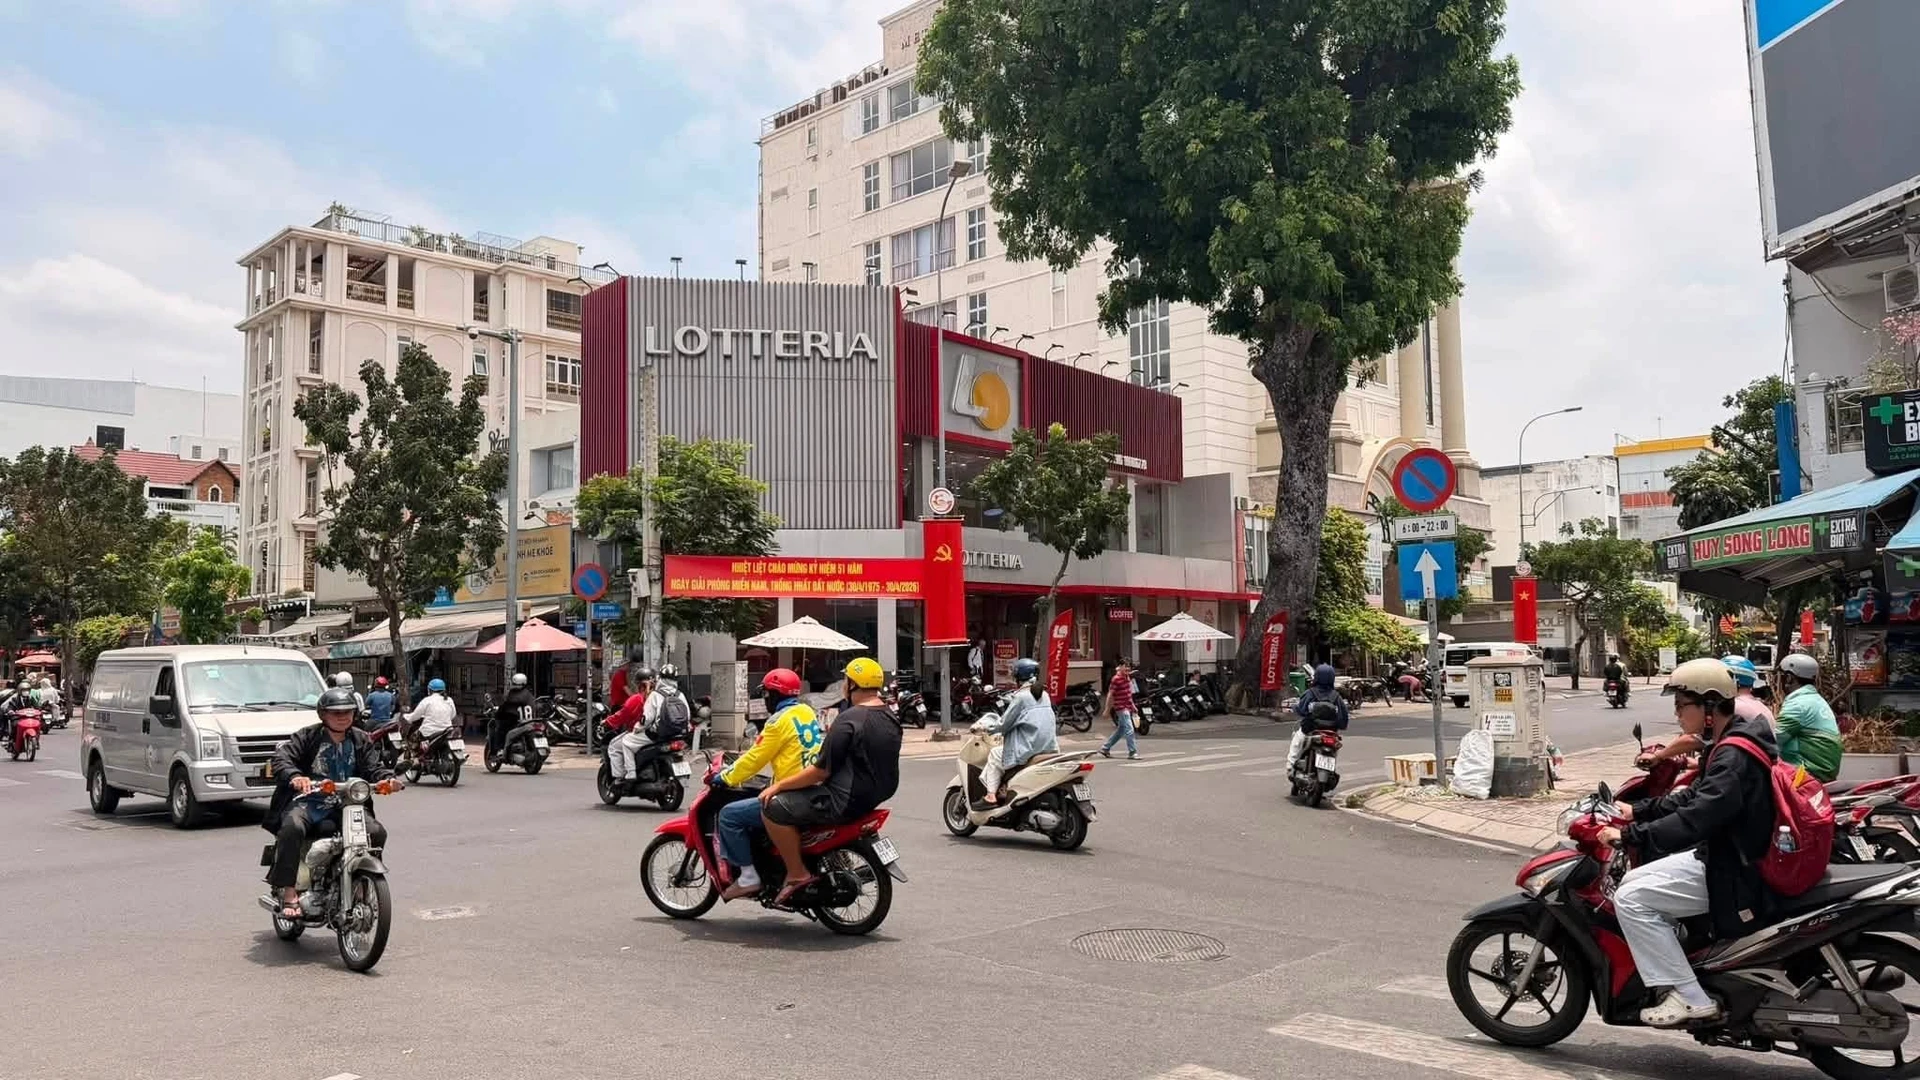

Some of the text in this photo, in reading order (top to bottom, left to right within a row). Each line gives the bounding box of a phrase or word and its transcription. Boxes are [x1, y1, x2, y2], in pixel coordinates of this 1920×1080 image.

[645, 325, 878, 360] LOTTERIA
[1830, 517, 1857, 533] EXTRA
[1692, 539, 1722, 562] HUY
[1723, 530, 1763, 557] SONG
[1767, 523, 1811, 551] LONG
[1830, 533, 1845, 548] BIO
[962, 549, 1024, 570] OTTERIA
[838, 563, 845, 574] 51
[517, 705, 533, 720] 18
